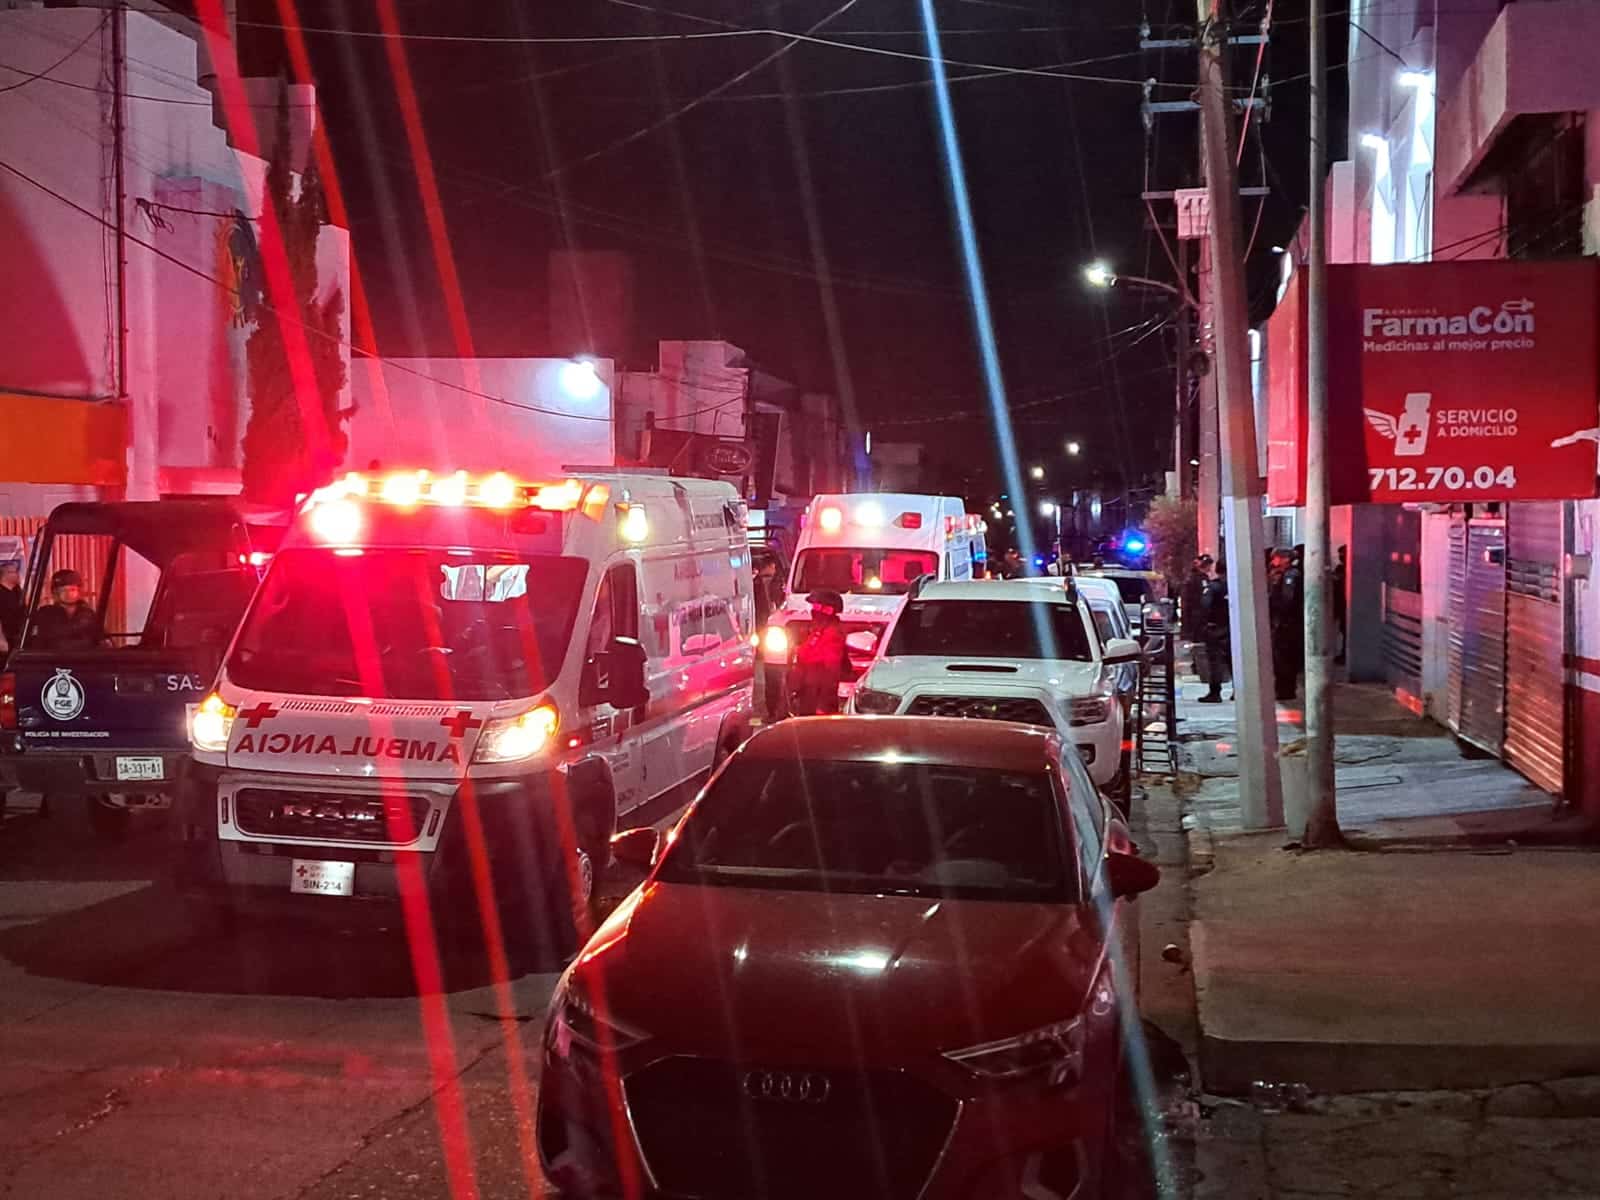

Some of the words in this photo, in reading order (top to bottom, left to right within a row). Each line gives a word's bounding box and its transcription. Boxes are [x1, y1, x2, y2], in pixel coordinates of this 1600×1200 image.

[1363, 340, 1429, 352] Medicinas
[1433, 339, 1445, 350] al
[1449, 339, 1490, 351] mejor
[1491, 338, 1534, 352] precio
[1437, 409, 1518, 424] SERVICIO
[1437, 428, 1446, 437] A
[1450, 426, 1518, 437] DOMICILIO
[1368, 466, 1516, 490] 712.70.04
